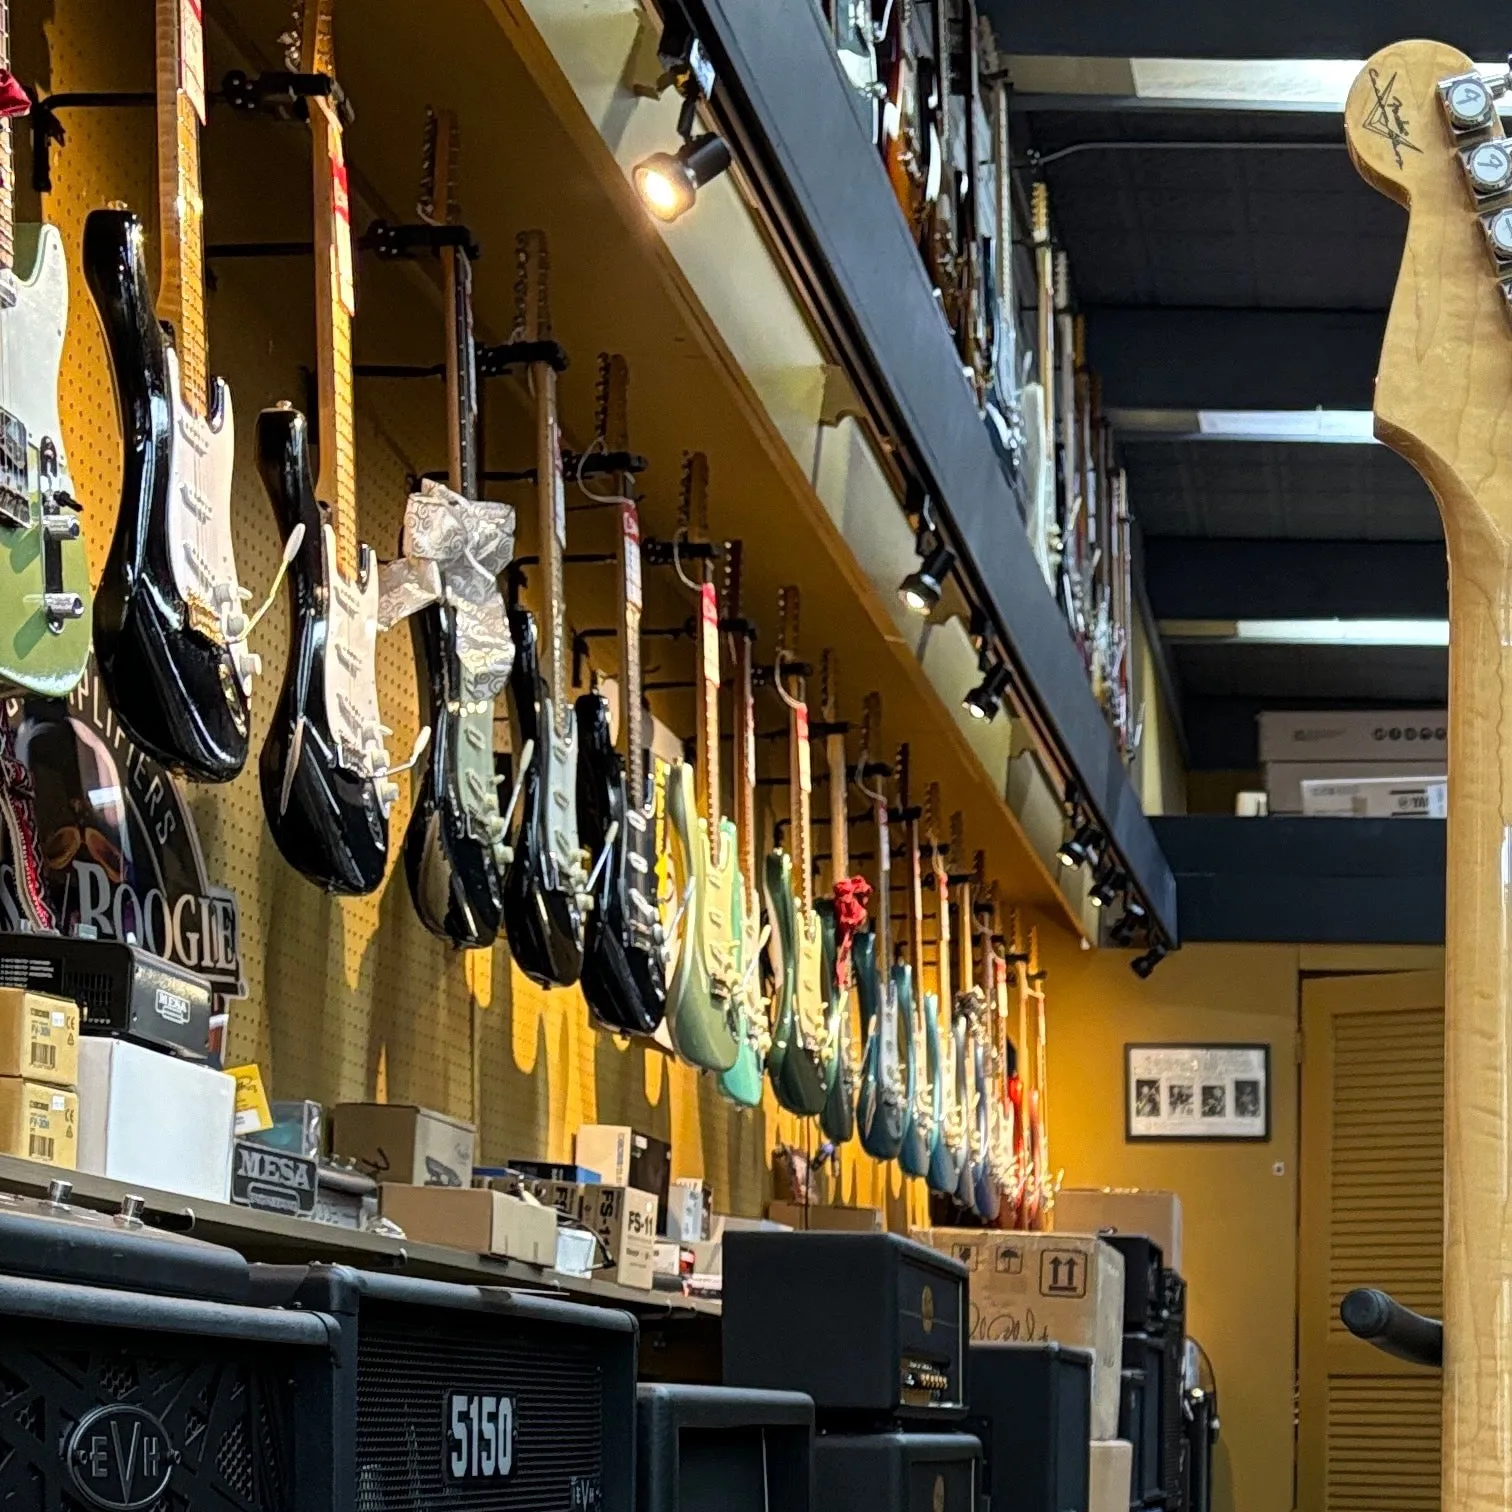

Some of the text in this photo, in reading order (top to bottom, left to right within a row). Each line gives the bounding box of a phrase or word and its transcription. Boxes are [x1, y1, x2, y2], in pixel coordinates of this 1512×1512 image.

[236, 1148, 311, 1191] MESA
[627, 1210, 654, 1237] FS-11
[90, 1420, 160, 1504] EVH
[452, 1395, 513, 1478] 5150
